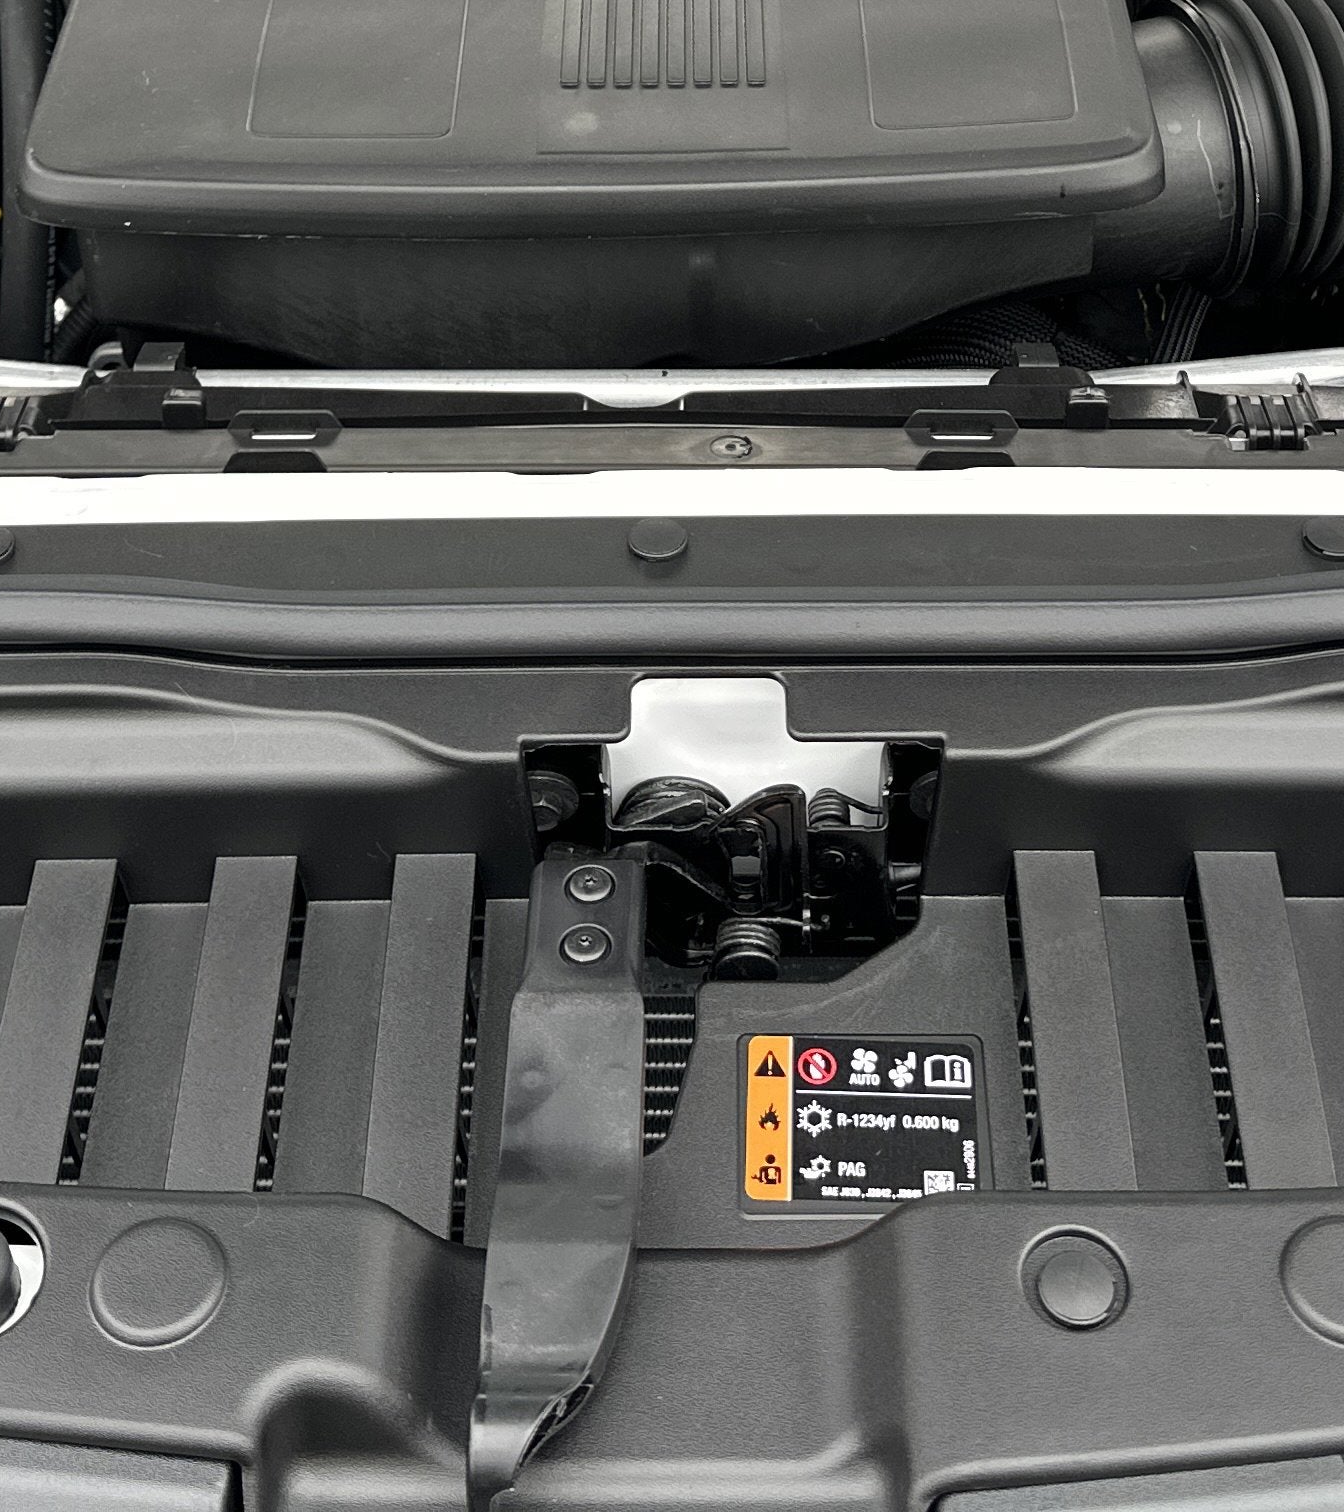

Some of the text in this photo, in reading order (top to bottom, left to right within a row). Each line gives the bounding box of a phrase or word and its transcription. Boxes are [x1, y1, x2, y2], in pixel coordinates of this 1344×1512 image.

[849, 1073, 880, 1086] AUTO
[837, 1112, 960, 1133] R-1234yf 0.600 kg
[837, 1161, 867, 1178] PAG
